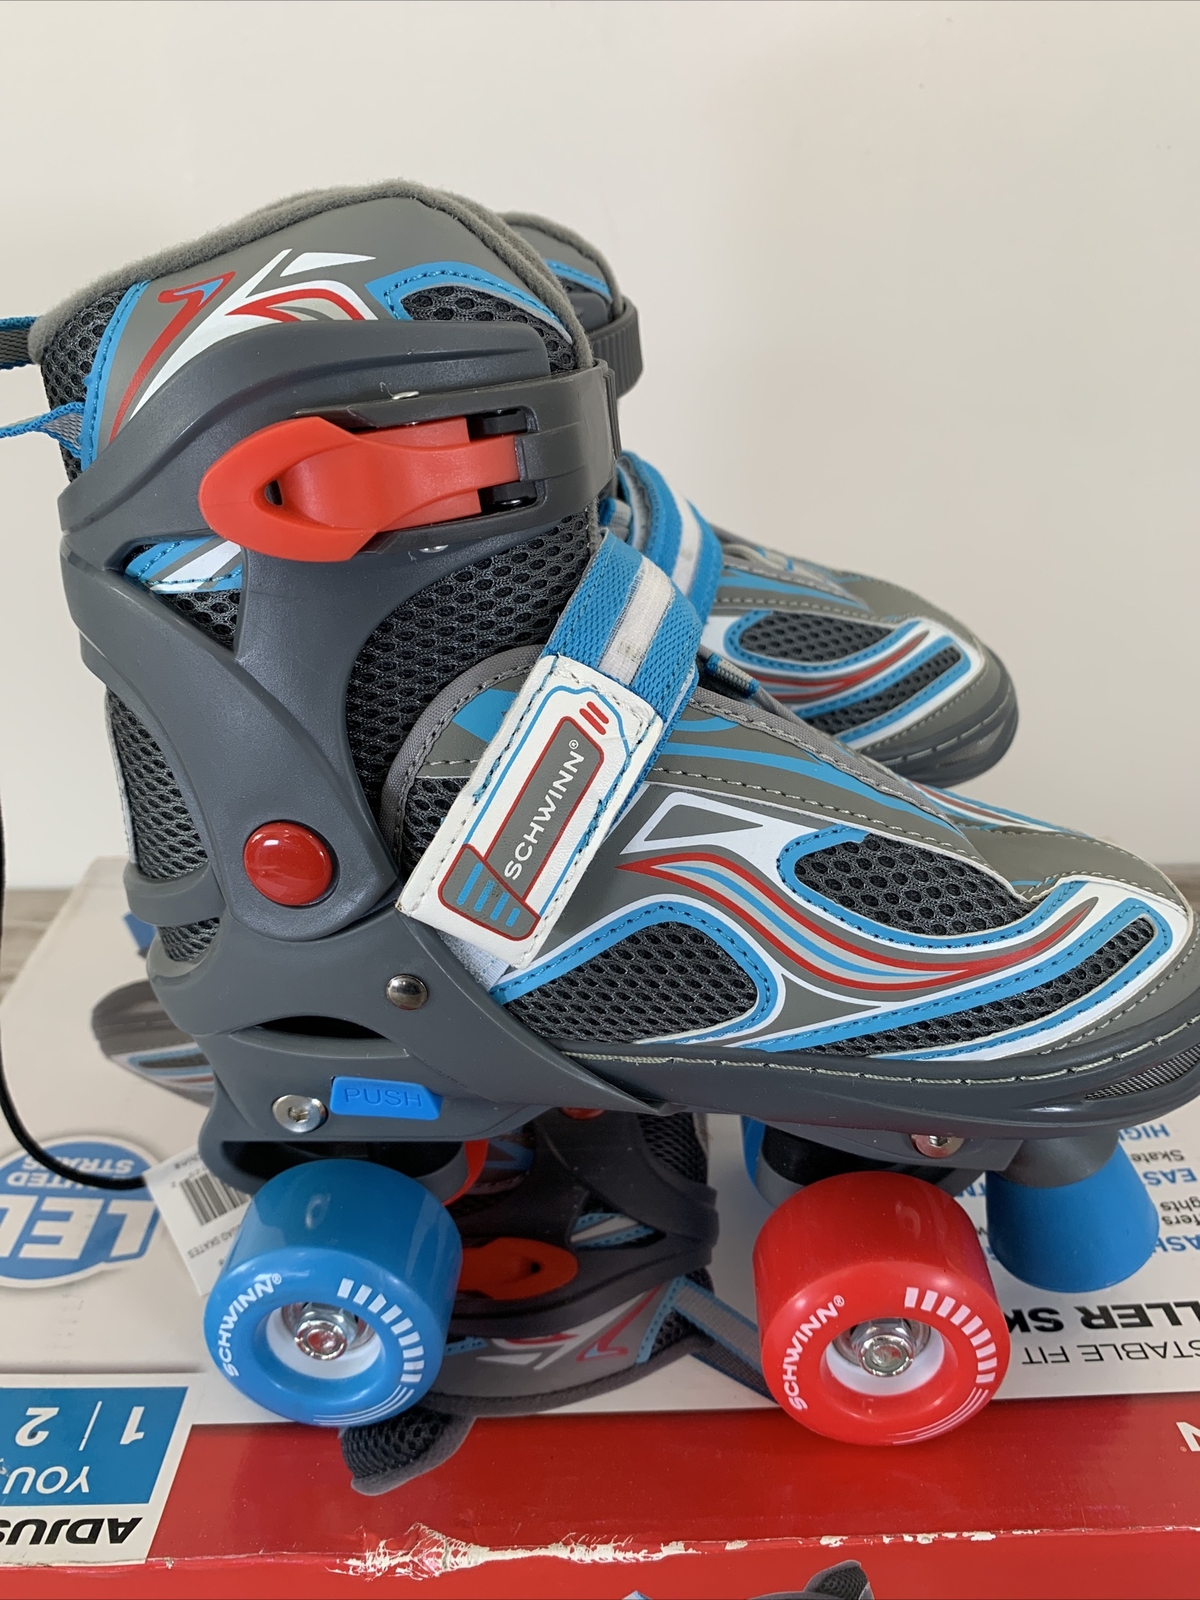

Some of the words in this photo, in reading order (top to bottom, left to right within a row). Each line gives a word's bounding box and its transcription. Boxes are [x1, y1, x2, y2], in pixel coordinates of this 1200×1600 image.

[343, 1087, 423, 1108] PUSH
[22, 1155, 135, 1175] STRAS
[1022, 1346, 1070, 1365] FIT
[15, 1407, 60, 1447] 2
[119, 1406, 145, 1445] 1
[2, 1466, 90, 1495] YOU
